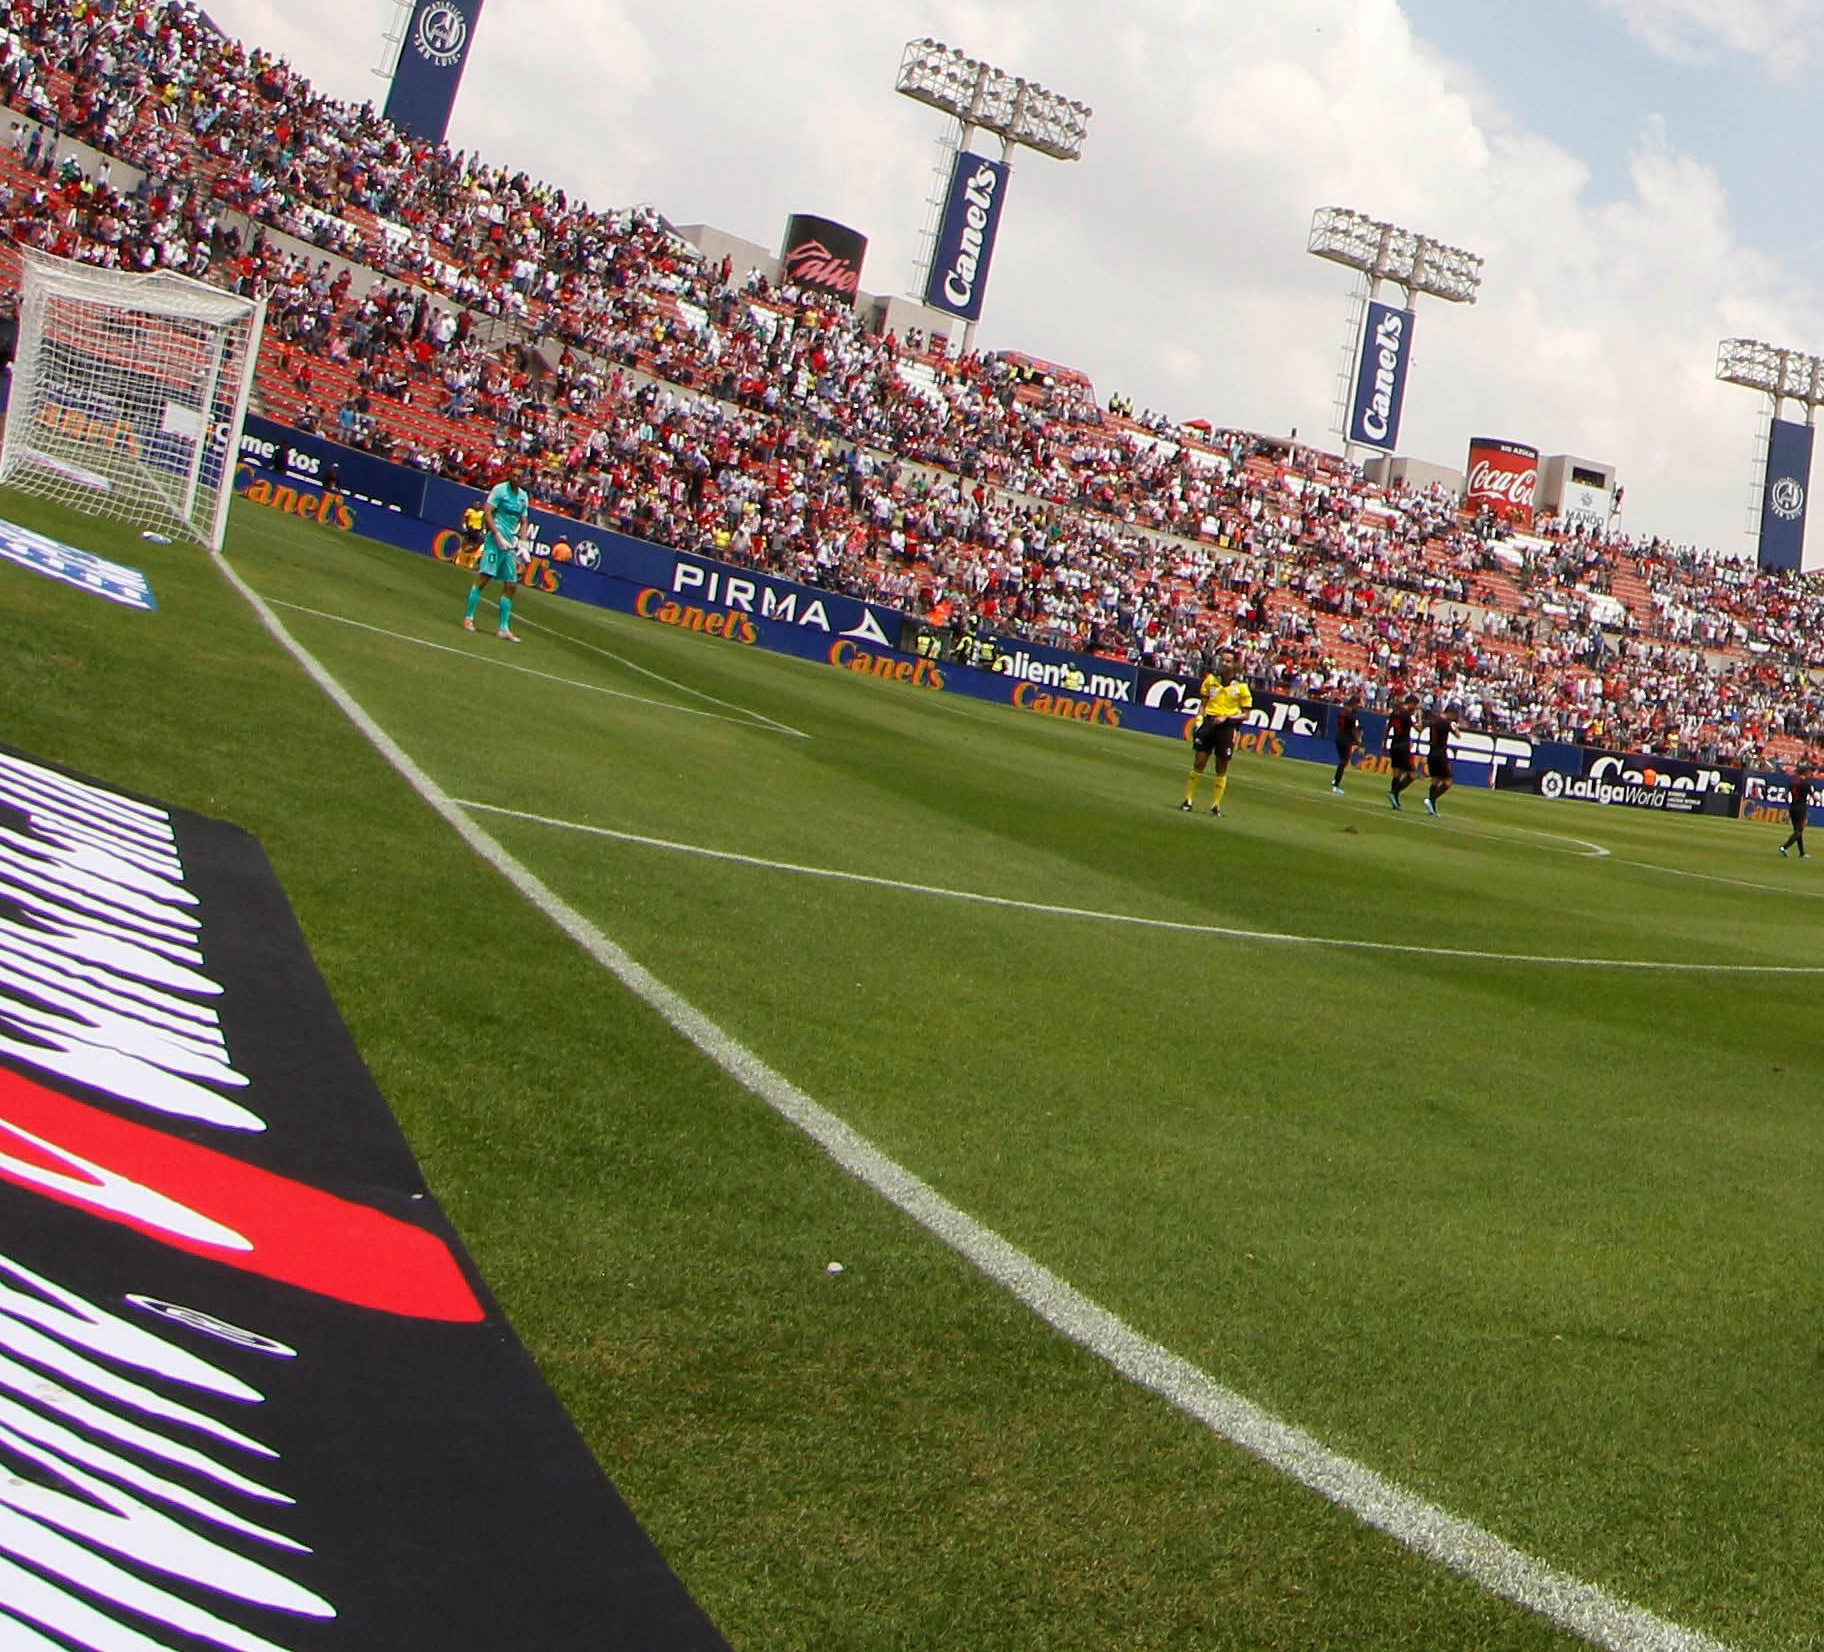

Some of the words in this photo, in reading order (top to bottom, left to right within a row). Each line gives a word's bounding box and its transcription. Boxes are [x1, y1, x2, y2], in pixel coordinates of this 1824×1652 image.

[944, 161, 998, 309] Canel's
[1362, 311, 1404, 442] Canel's
[635, 587, 760, 645] Canel's
[672, 562, 831, 633] PIRMA
[830, 638, 946, 692] Canel's
[1012, 681, 1121, 728] Canel's
